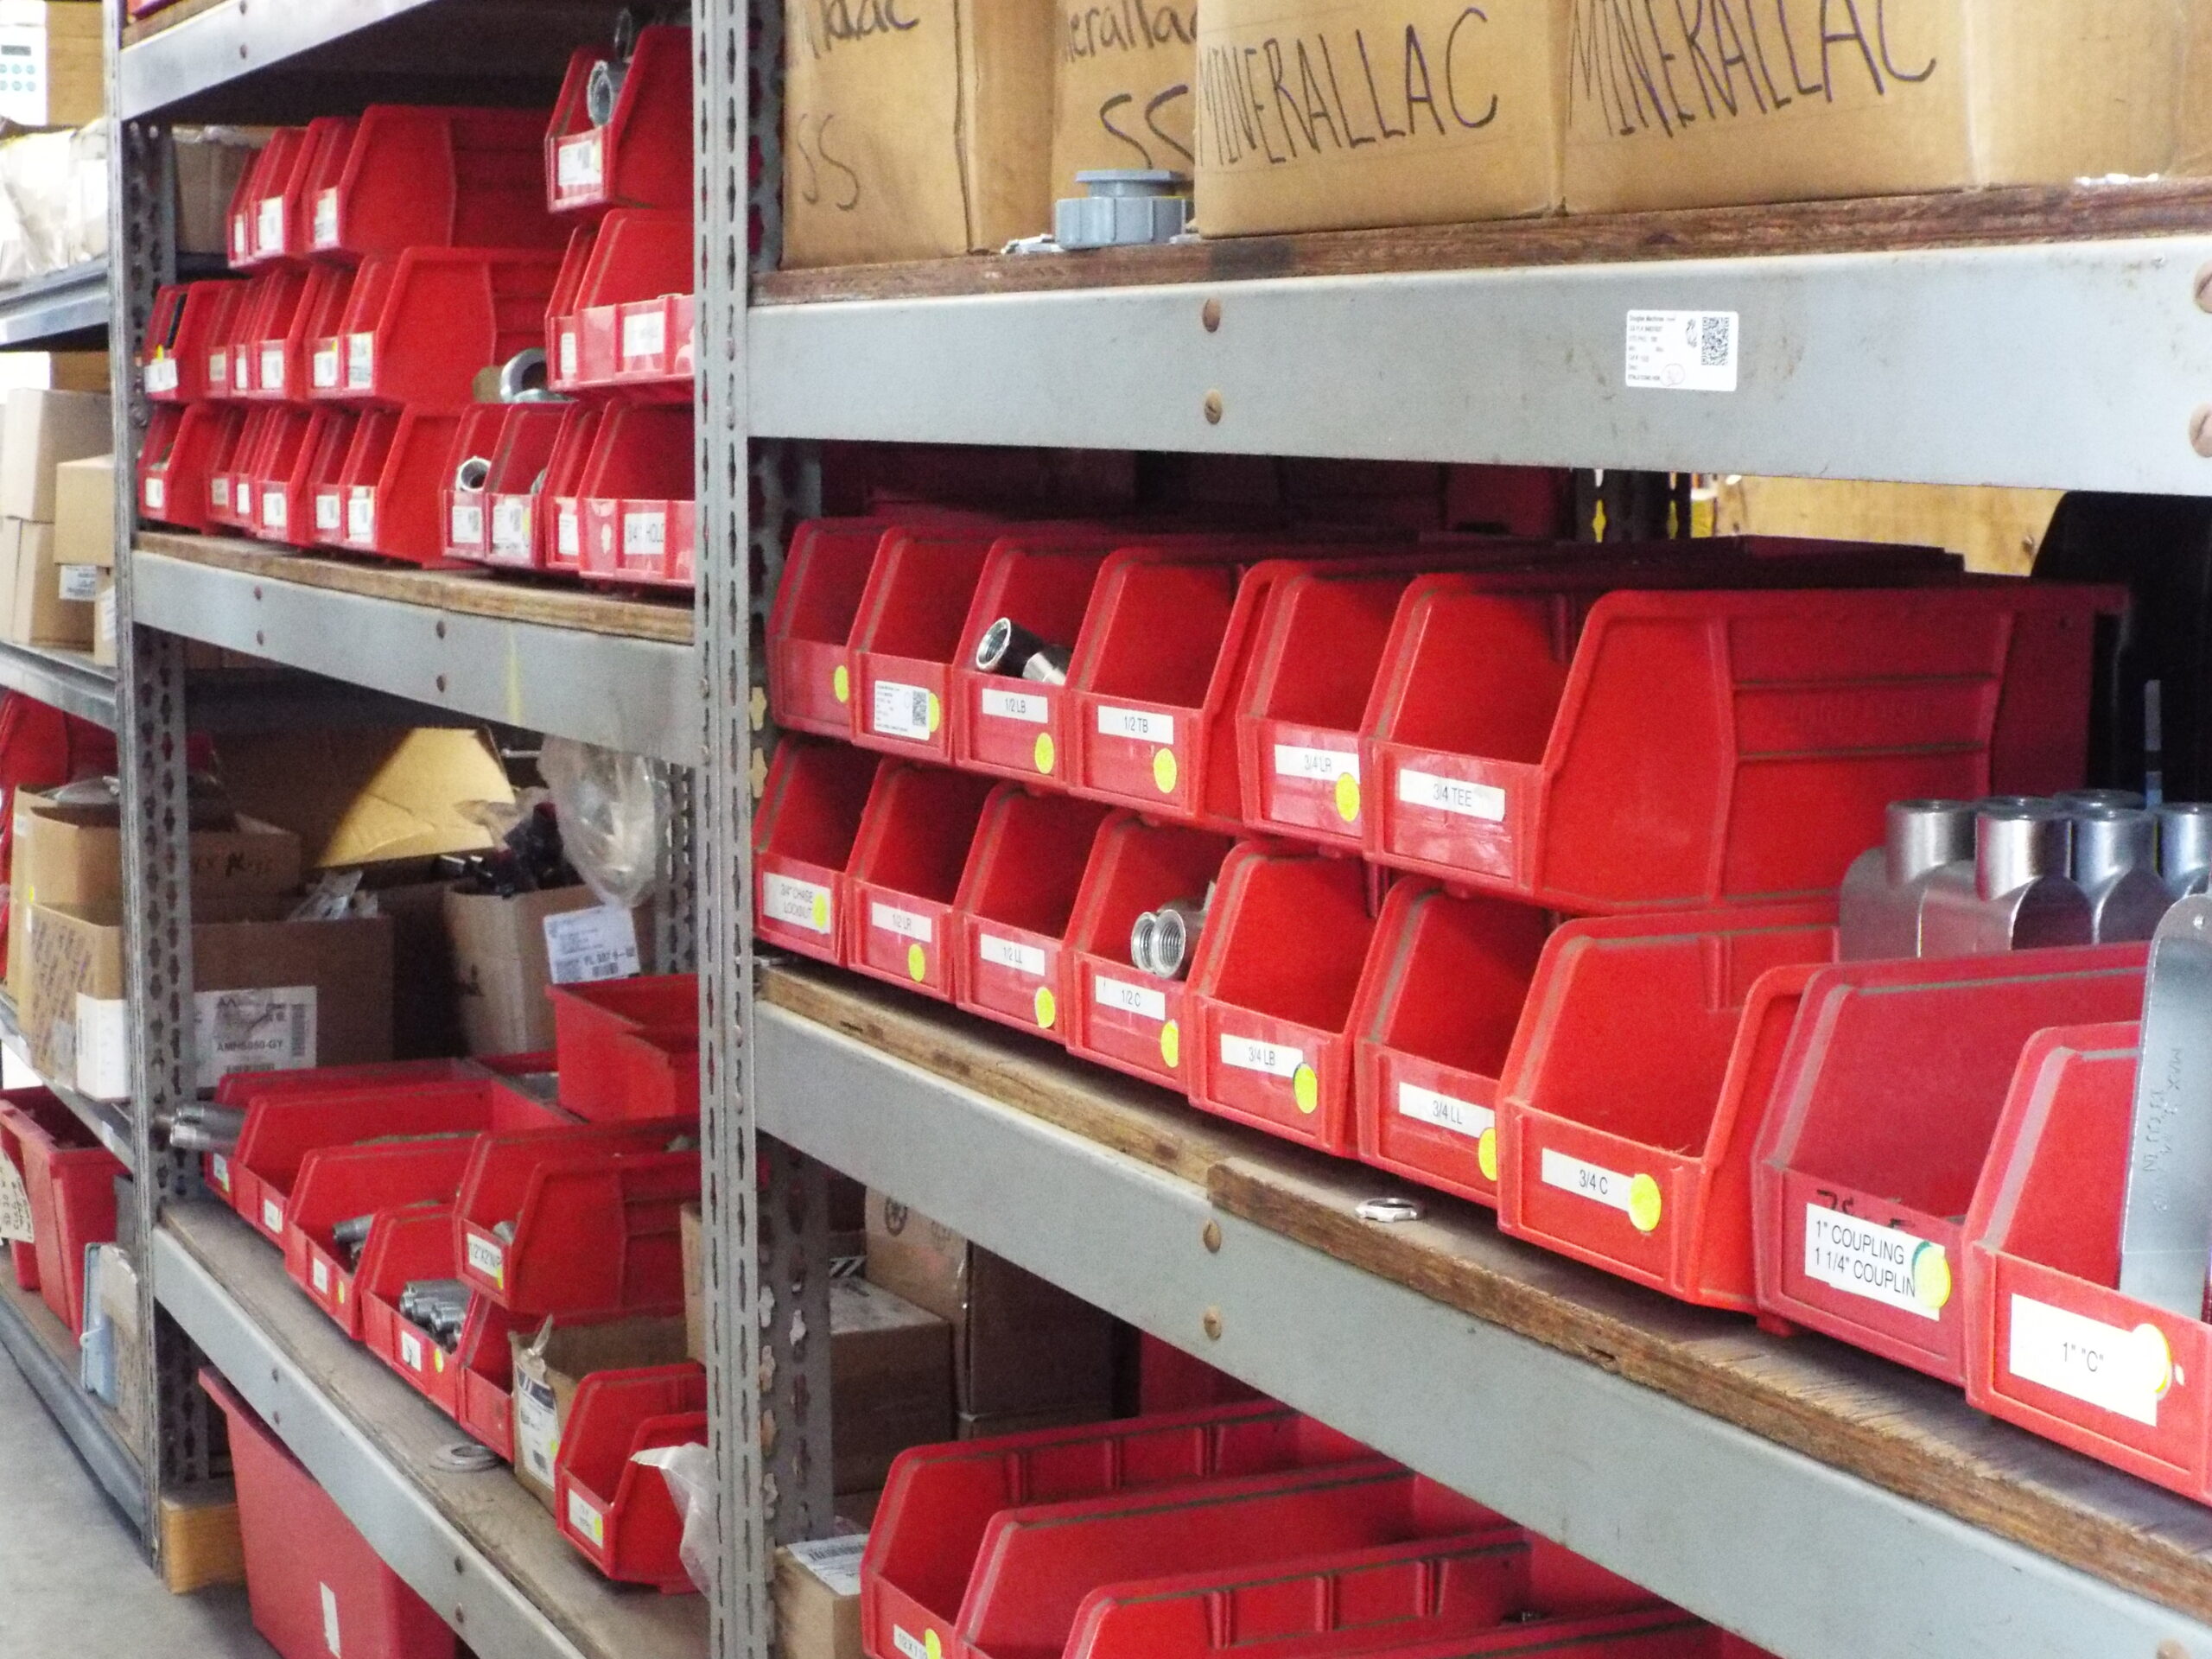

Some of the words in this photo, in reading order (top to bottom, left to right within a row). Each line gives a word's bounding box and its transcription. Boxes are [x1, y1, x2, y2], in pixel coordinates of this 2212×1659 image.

[1198, 7, 1499, 166] MINERALLAC
[1005, 697, 1016, 713] 1/2
[1016, 699, 1027, 714] LB
[1124, 715, 1136, 732] 1/2
[1136, 717, 1148, 734] TB
[1433, 783, 1449, 803] 3/4
[1451, 786, 1472, 808] TEE
[1122, 989, 1134, 1005] 1/2
[1134, 992, 1141, 1007] C
[1248, 1046, 1262, 1063] 3/4
[1263, 1048, 1275, 1066] LB
[1433, 1099, 1449, 1121] 3/4
[1451, 1105, 1463, 1125] LL
[1579, 1168, 1597, 1191] 3/4
[1599, 1176, 1609, 1195] C
[1816, 1219, 1828, 1238] 1"
[1831, 1224, 1905, 1266] COUPLING
[1827, 1250, 1851, 1274] 1/4"
[1853, 1259, 1916, 1299] COUPLIN
